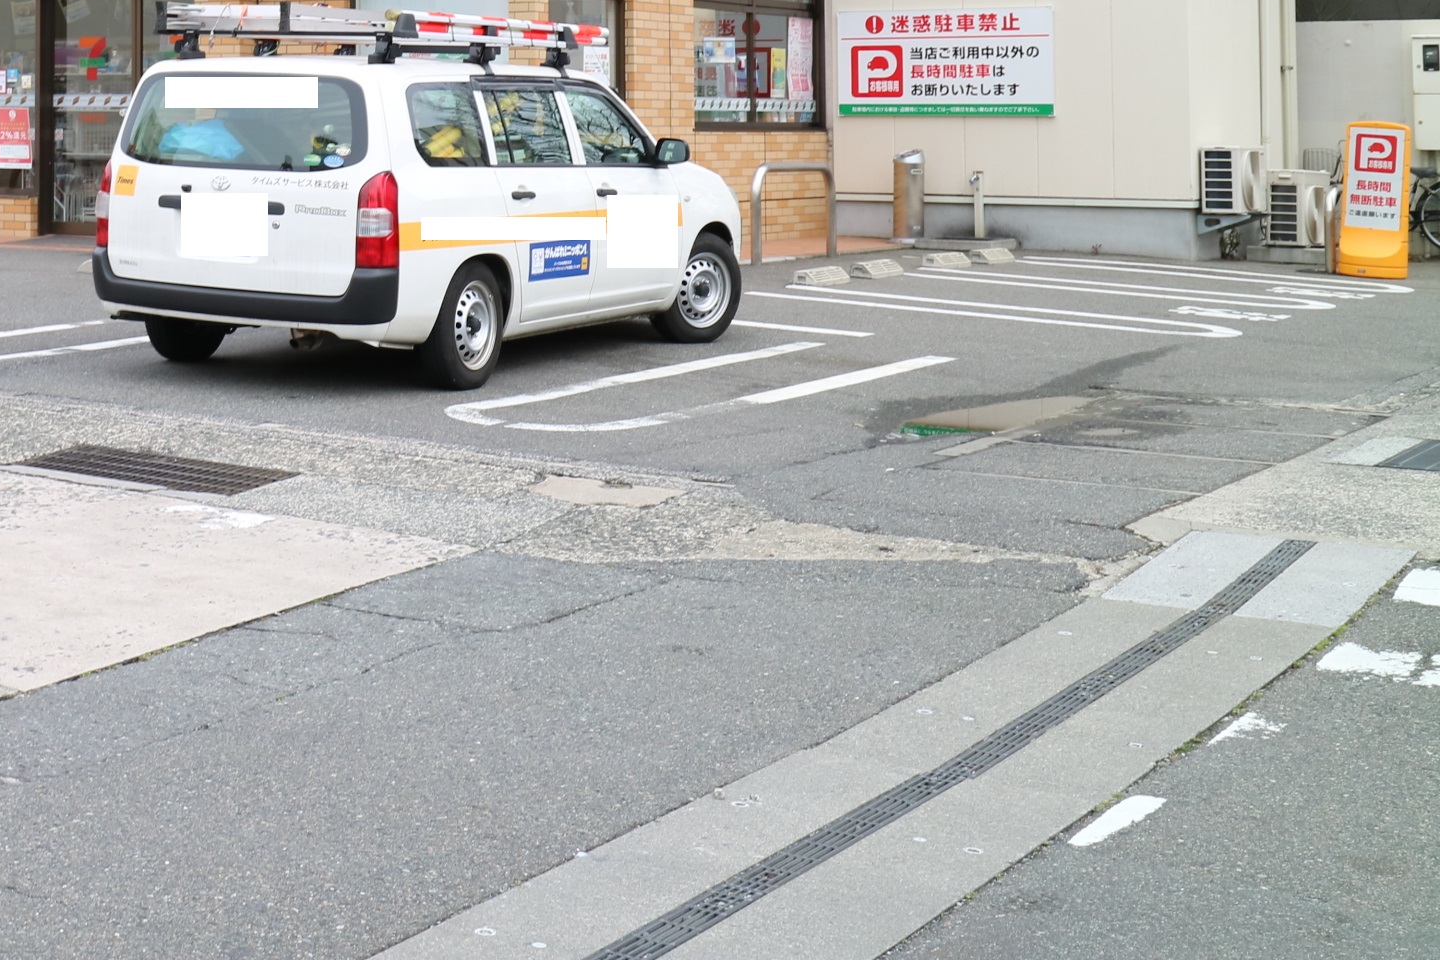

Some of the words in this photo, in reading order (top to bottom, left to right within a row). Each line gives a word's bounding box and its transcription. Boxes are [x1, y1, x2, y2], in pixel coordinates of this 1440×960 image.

[891, 13, 1020, 33] 迷惑駐車禁止
[910, 46, 1040, 60] 当店ご利用中以外の
[910, 64, 1006, 79] 長時間駐車は
[869, 80, 900, 93] お客様専用
[911, 83, 1020, 97] お断りいたします
[117, 176, 134, 184] Times
[251, 176, 349, 190] タイムズサービス株式会社
[1356, 179, 1392, 193] 長時間
[1350, 193, 1397, 207] 無断駐車
